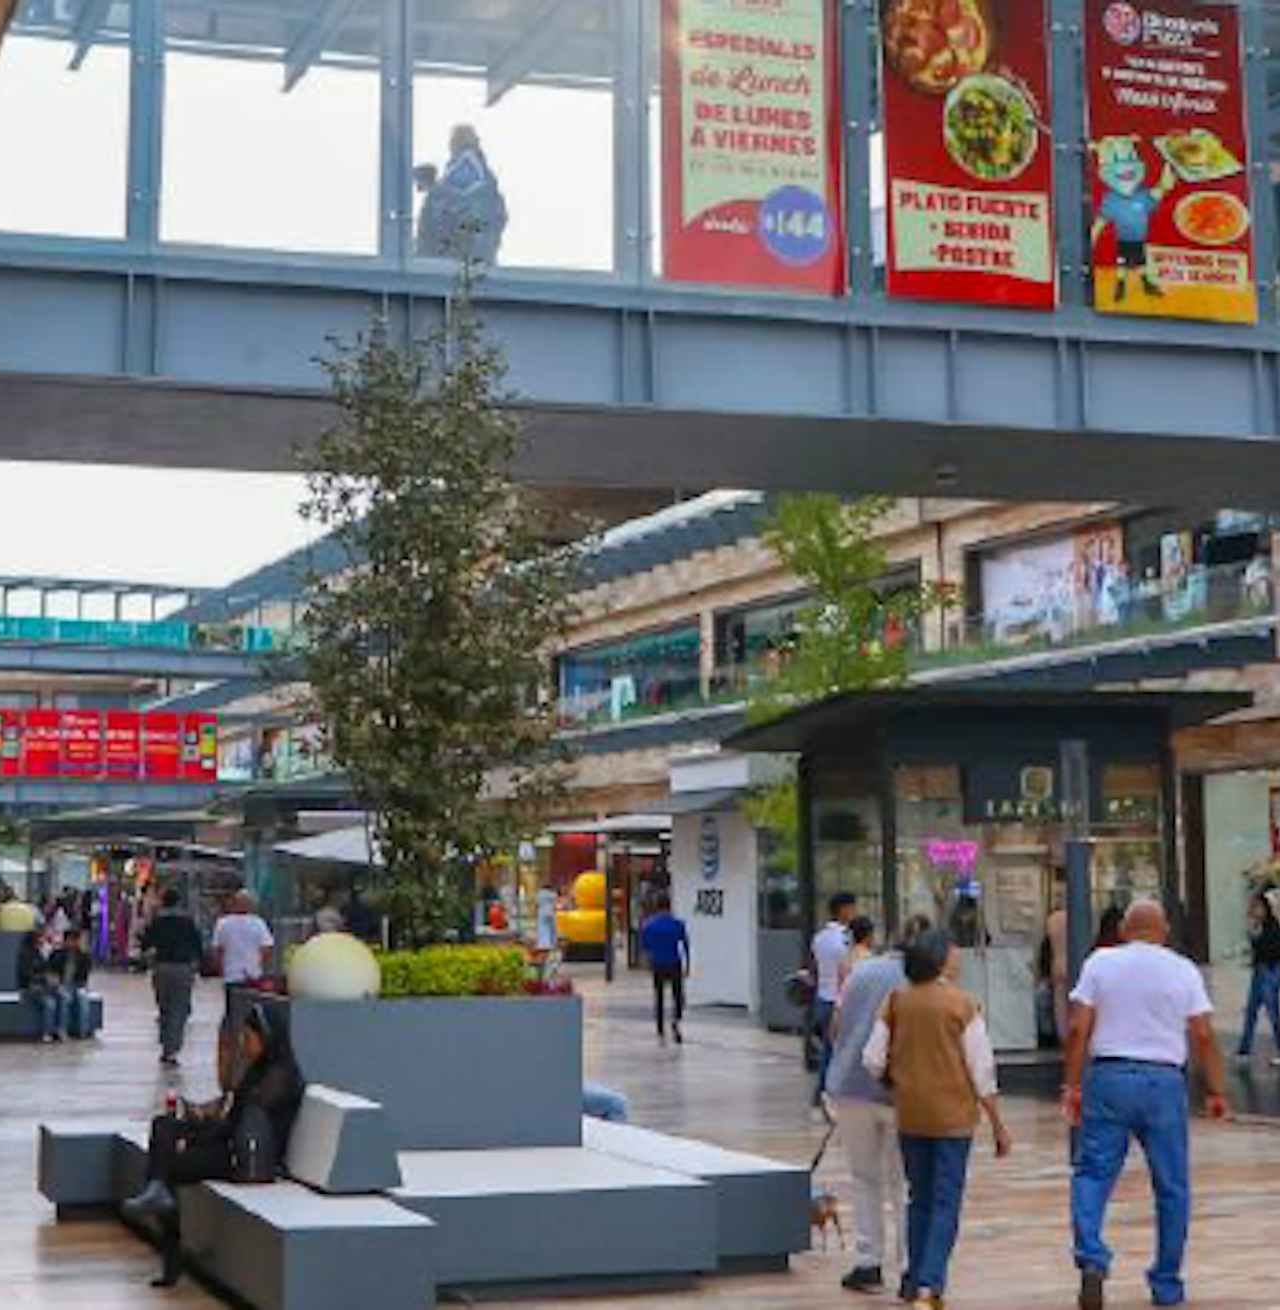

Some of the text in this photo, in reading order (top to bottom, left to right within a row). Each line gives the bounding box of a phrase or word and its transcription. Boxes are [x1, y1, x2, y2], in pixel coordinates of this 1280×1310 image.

[689, 31, 816, 60] ESPECIALES
[690, 64, 811, 97] de Lunch
[696, 101, 812, 130] DE LUNES
[690, 126, 816, 155] A VIERNES
[899, 192, 1040, 221] PLATO FUENTE
